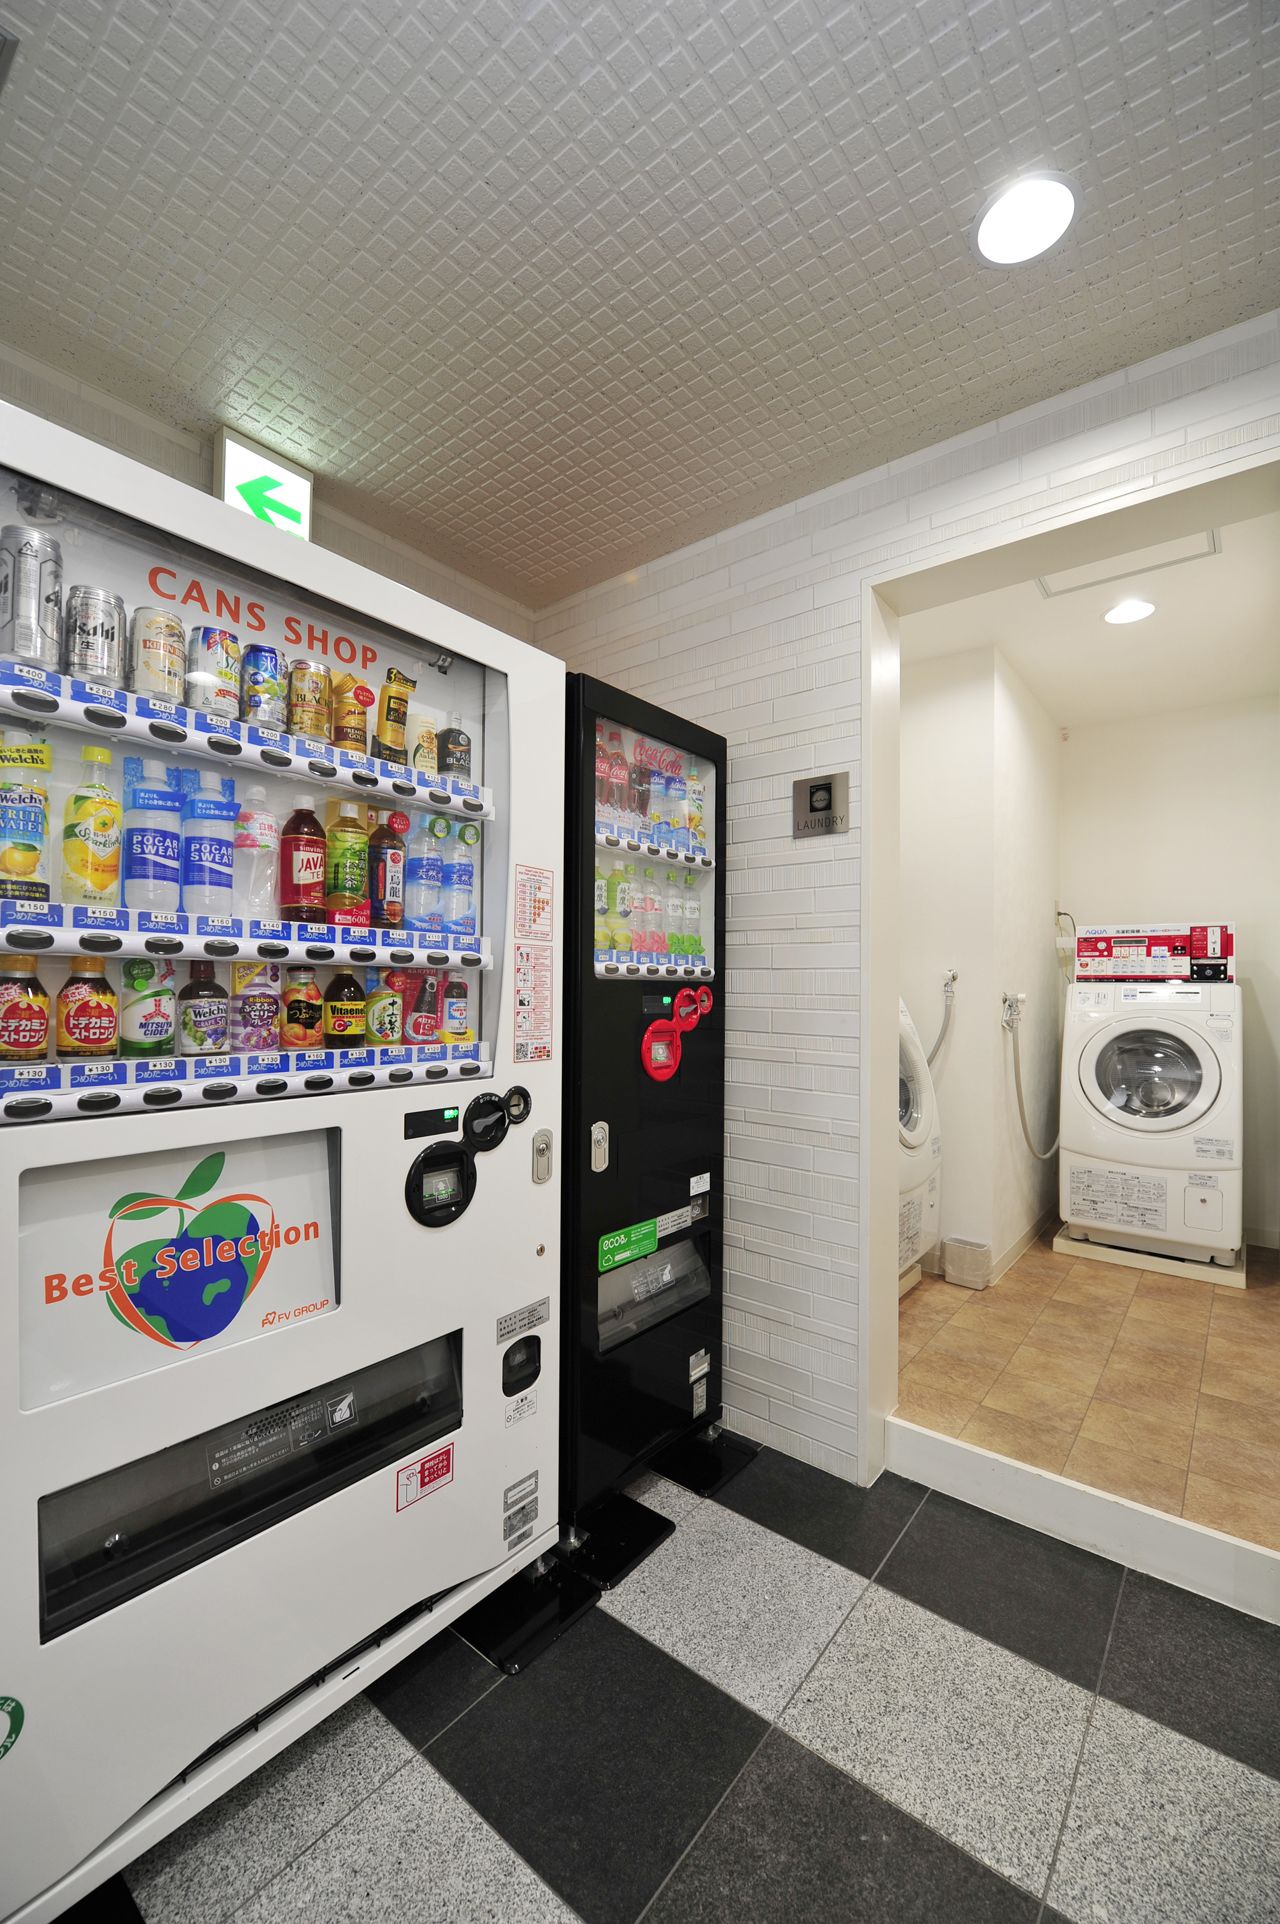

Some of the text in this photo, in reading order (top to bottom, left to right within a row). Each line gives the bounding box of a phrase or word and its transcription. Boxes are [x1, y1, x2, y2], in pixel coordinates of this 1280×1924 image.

[148, 566, 377, 670] CANS SHOP
[146, 640, 174, 654] KIRIN
[18, 668, 43, 680] ¥400
[89, 685, 112, 697] ¥280
[152, 701, 173, 712] ¥280
[209, 717, 228, 726] ¥200
[261, 730, 278, 739] ¥200
[343, 727, 366, 736] PREMI
[0, 755, 45, 765] Welch's
[446, 757, 470, 767] BLAC
[633, 737, 684, 776] Coca-Cola
[796, 815, 846, 831] LAUNDRY
[133, 835, 178, 848] POCAR
[132, 844, 178, 857] SWEAT
[191, 844, 233, 855] POCAR
[190, 852, 233, 864] SWEAT
[298, 855, 323, 873] JAVA
[20, 903, 44, 911] ¥150
[91, 909, 114, 917] ¥150
[250, 1010, 273, 1019] ゼリー
[69, 1016, 116, 1028] ドデカミン
[139, 1021, 172, 1029] MITSUYA
[216, 1017, 226, 1026] 50
[416, 1017, 436, 1025] オロナミ
[0, 1032, 45, 1043] ストロング
[71, 1028, 115, 1040] ストロング
[143, 1028, 169, 1036] CIDER
[88, 1065, 110, 1073] ¥130
[44, 1220, 319, 1304] Best Selection
[294, 1299, 329, 1318] GROUP
